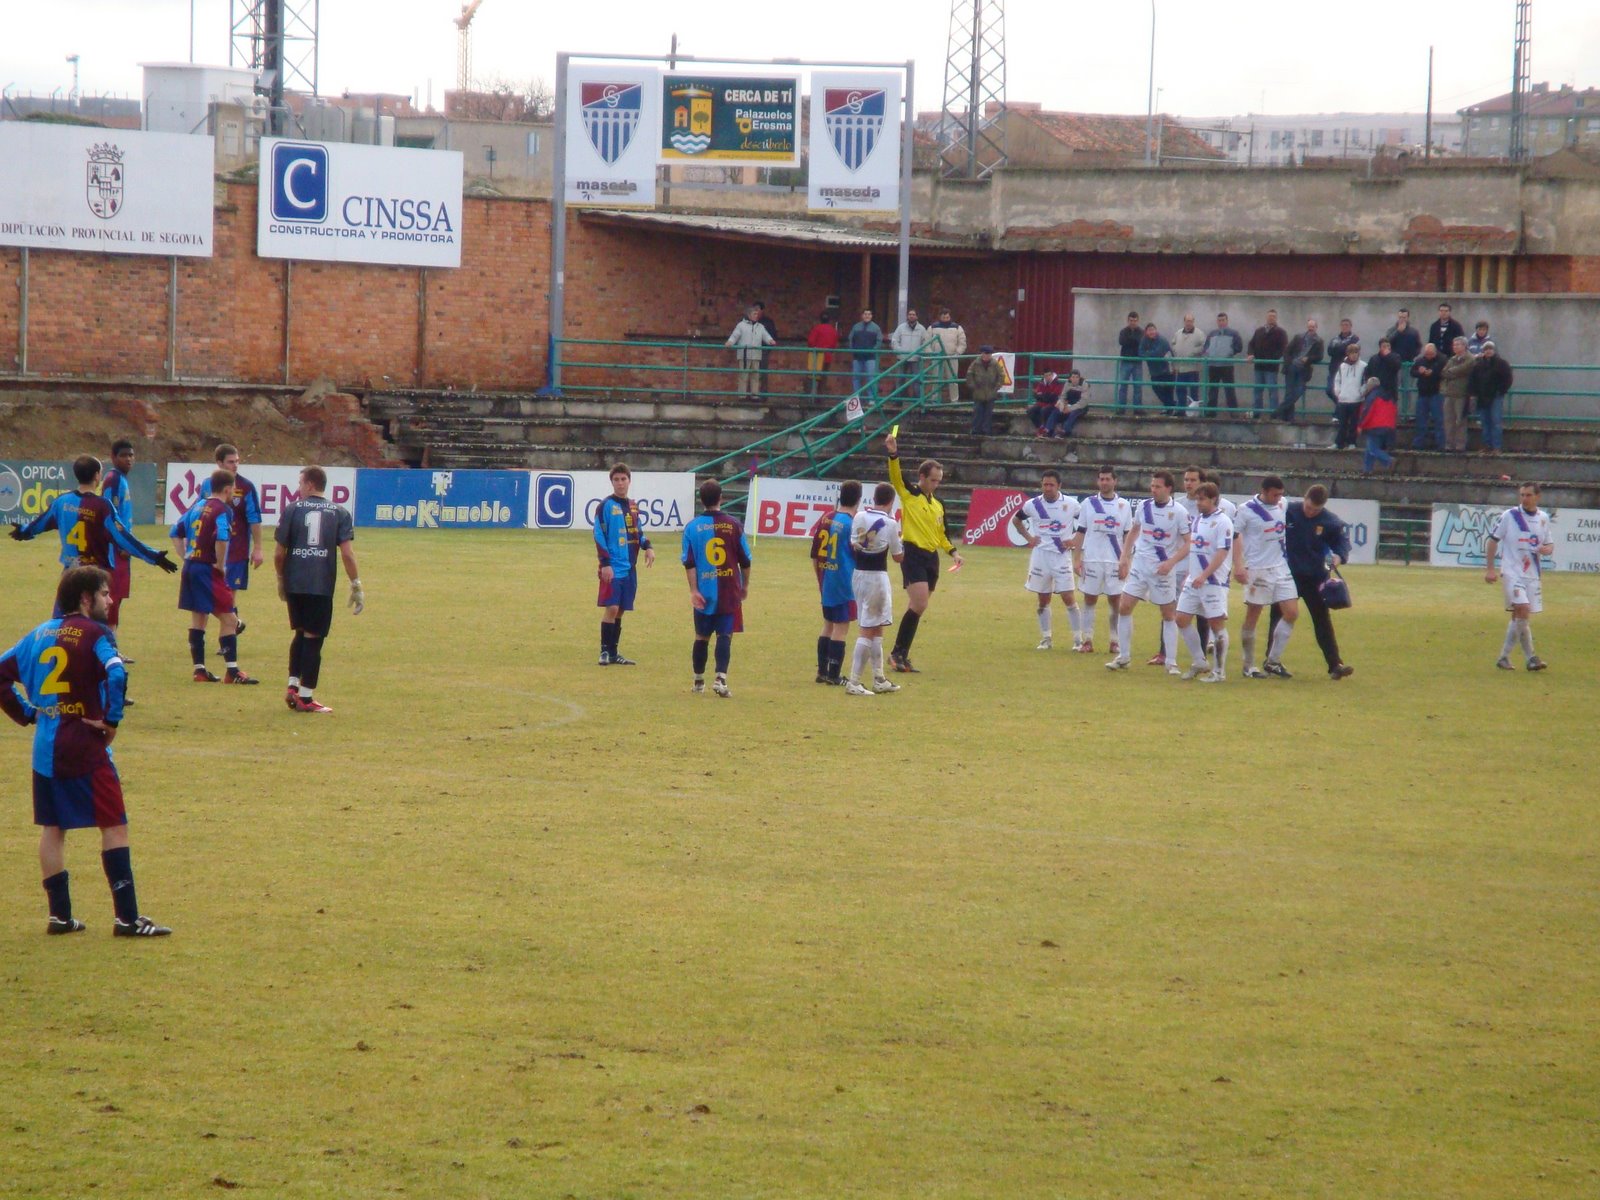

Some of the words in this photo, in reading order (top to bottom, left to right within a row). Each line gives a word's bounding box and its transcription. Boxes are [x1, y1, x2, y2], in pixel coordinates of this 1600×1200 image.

[724, 89, 762, 103] CERCA
[764, 90, 779, 103] DE
[735, 108, 793, 120] Palazuelos
[752, 119, 792, 131] Eresma
[283, 157, 317, 209] C
[576, 179, 638, 191] maseda
[820, 186, 881, 198] maseda
[342, 195, 454, 232] CINSSA
[1, 222, 66, 237] DIPUTACION
[71, 227, 136, 242] PROVINCIAL
[141, 231, 155, 243] DE
[159, 233, 204, 246] SEGOVIA
[269, 224, 366, 239] CONSTRUCTORA
[371, 230, 378, 240] Y
[381, 231, 454, 244] PROMOTORA
[21, 465, 66, 480] OPTICA
[543, 484, 566, 519] C
[795, 493, 833, 503] MINERAL
[584, 498, 684, 528] CSSA
[965, 493, 1023, 545] Serigrafía
[66, 520, 88, 552] 4
[304, 510, 322, 546] 1
[705, 537, 727, 566] 6
[817, 529, 839, 560] 21
[38, 645, 71, 695] 2
